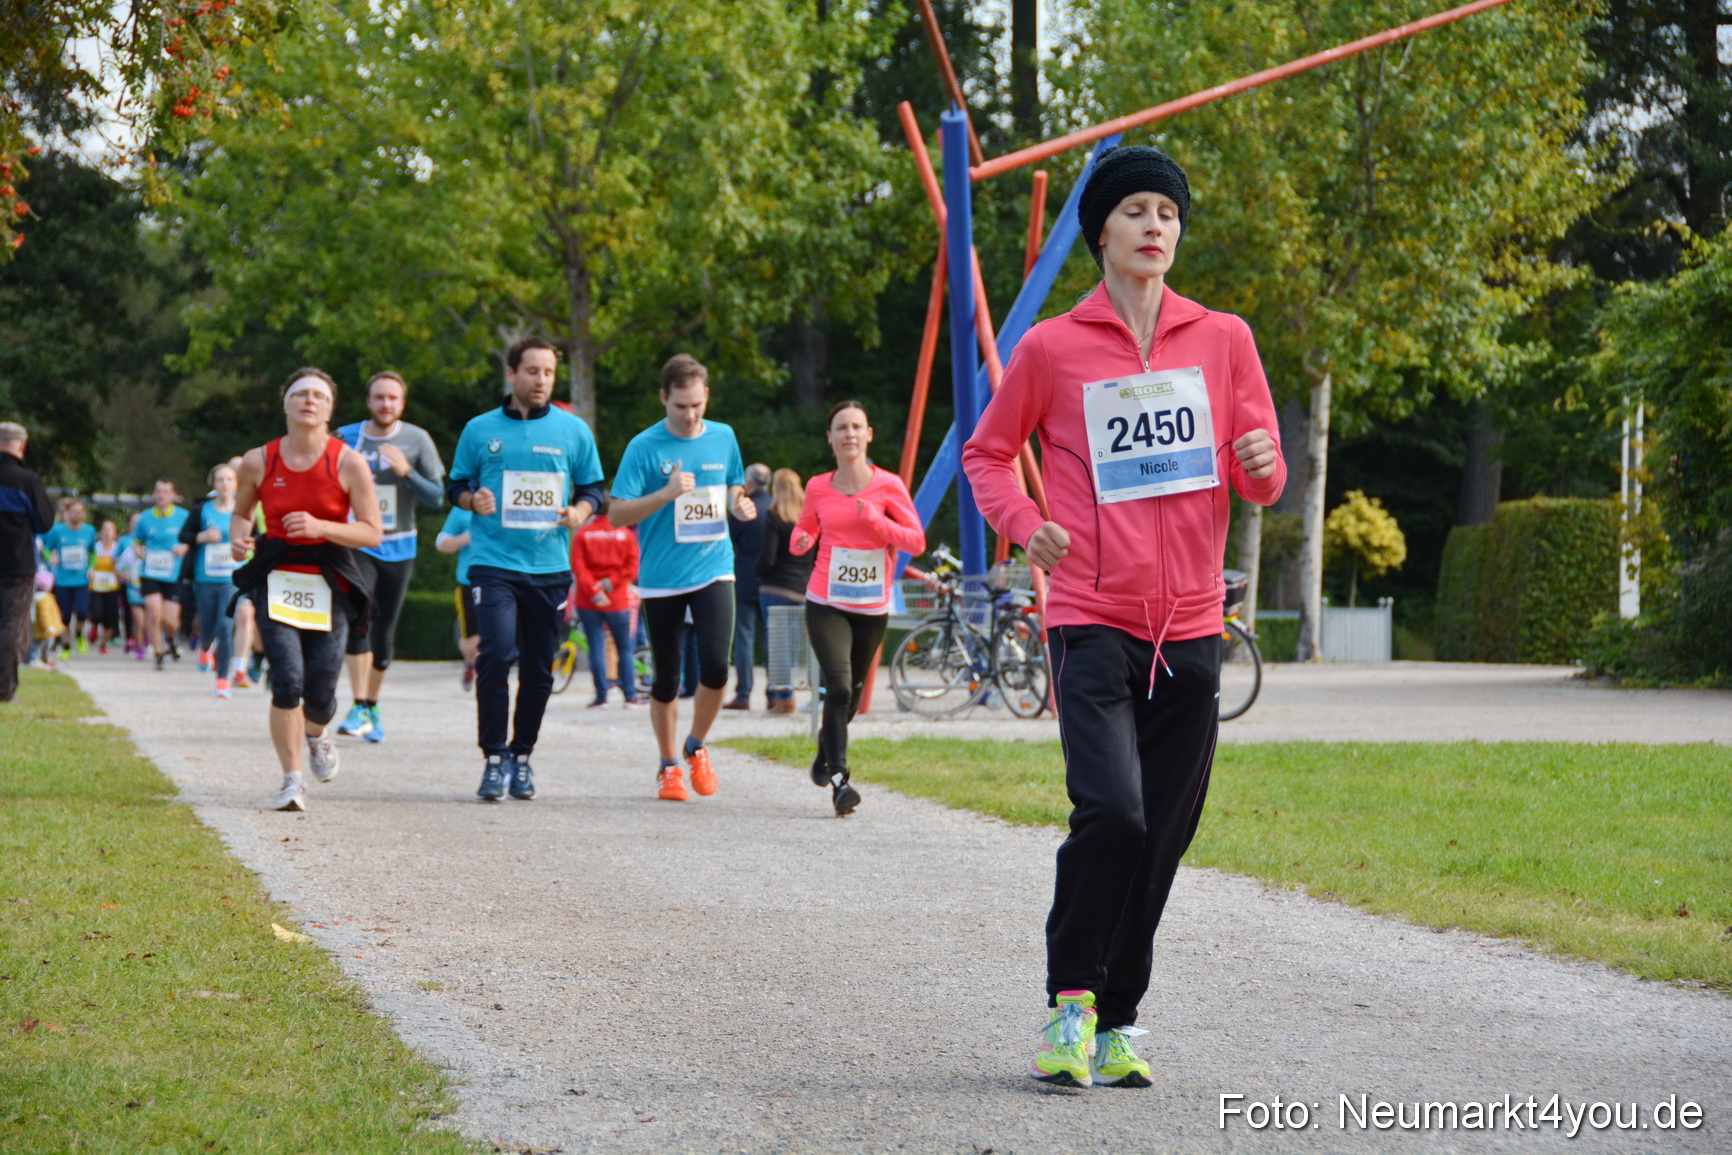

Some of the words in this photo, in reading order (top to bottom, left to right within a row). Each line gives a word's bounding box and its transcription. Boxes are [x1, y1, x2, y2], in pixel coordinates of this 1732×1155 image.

[1132, 382, 1175, 397] BOCK
[1106, 406, 1195, 454] 2450
[1097, 450, 1104, 458] D
[1139, 459, 1179, 476] Nicole
[512, 489, 554, 507] 2938
[683, 503, 719, 521] 2941
[837, 565, 877, 583] 2934
[282, 590, 315, 609] 285
